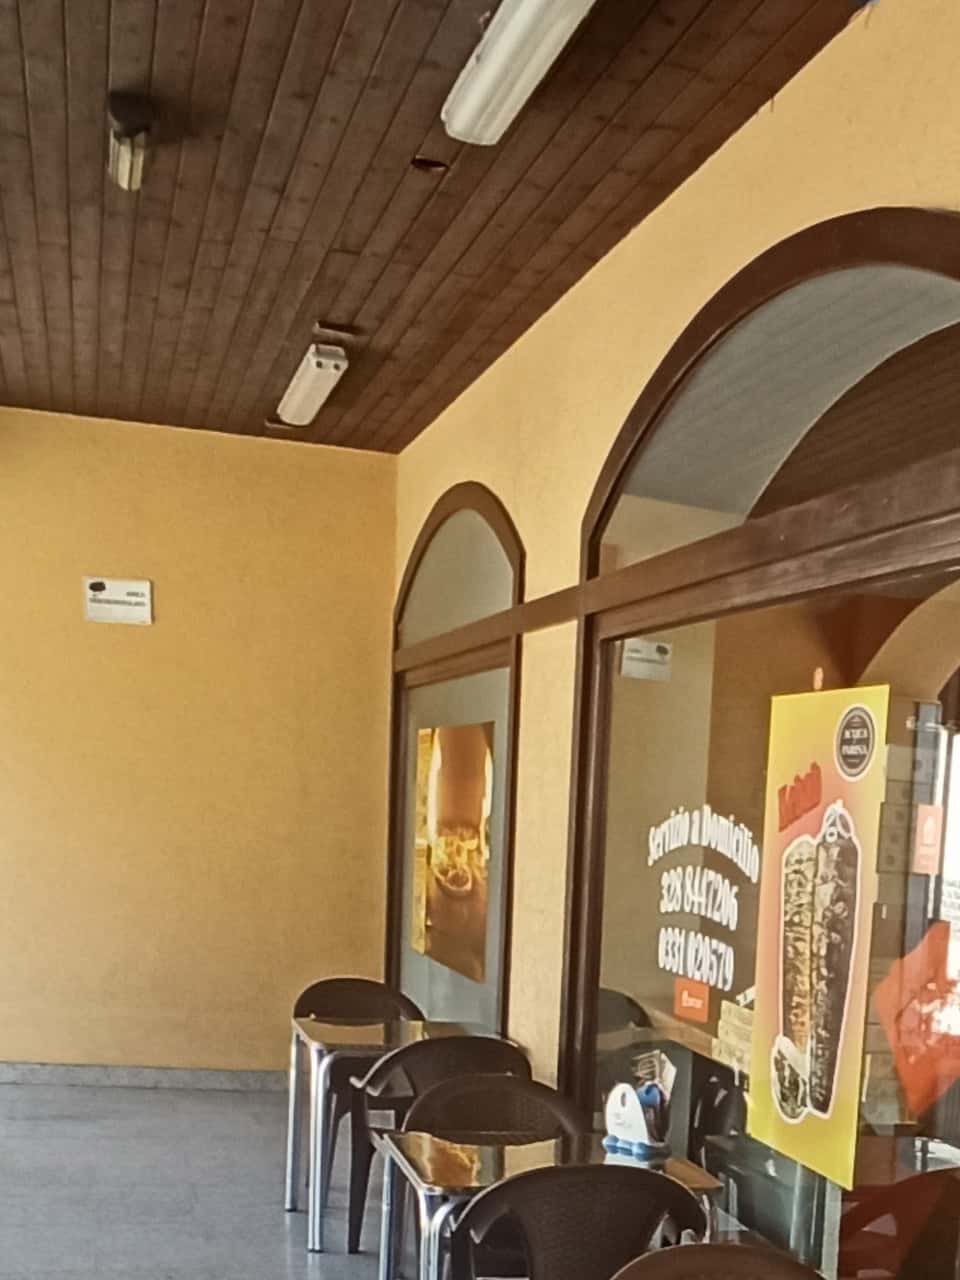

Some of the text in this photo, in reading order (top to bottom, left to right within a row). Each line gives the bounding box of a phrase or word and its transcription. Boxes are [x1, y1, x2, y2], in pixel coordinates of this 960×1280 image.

[659, 865, 683, 914] 328
[658, 926, 735, 992] 0331 020579
